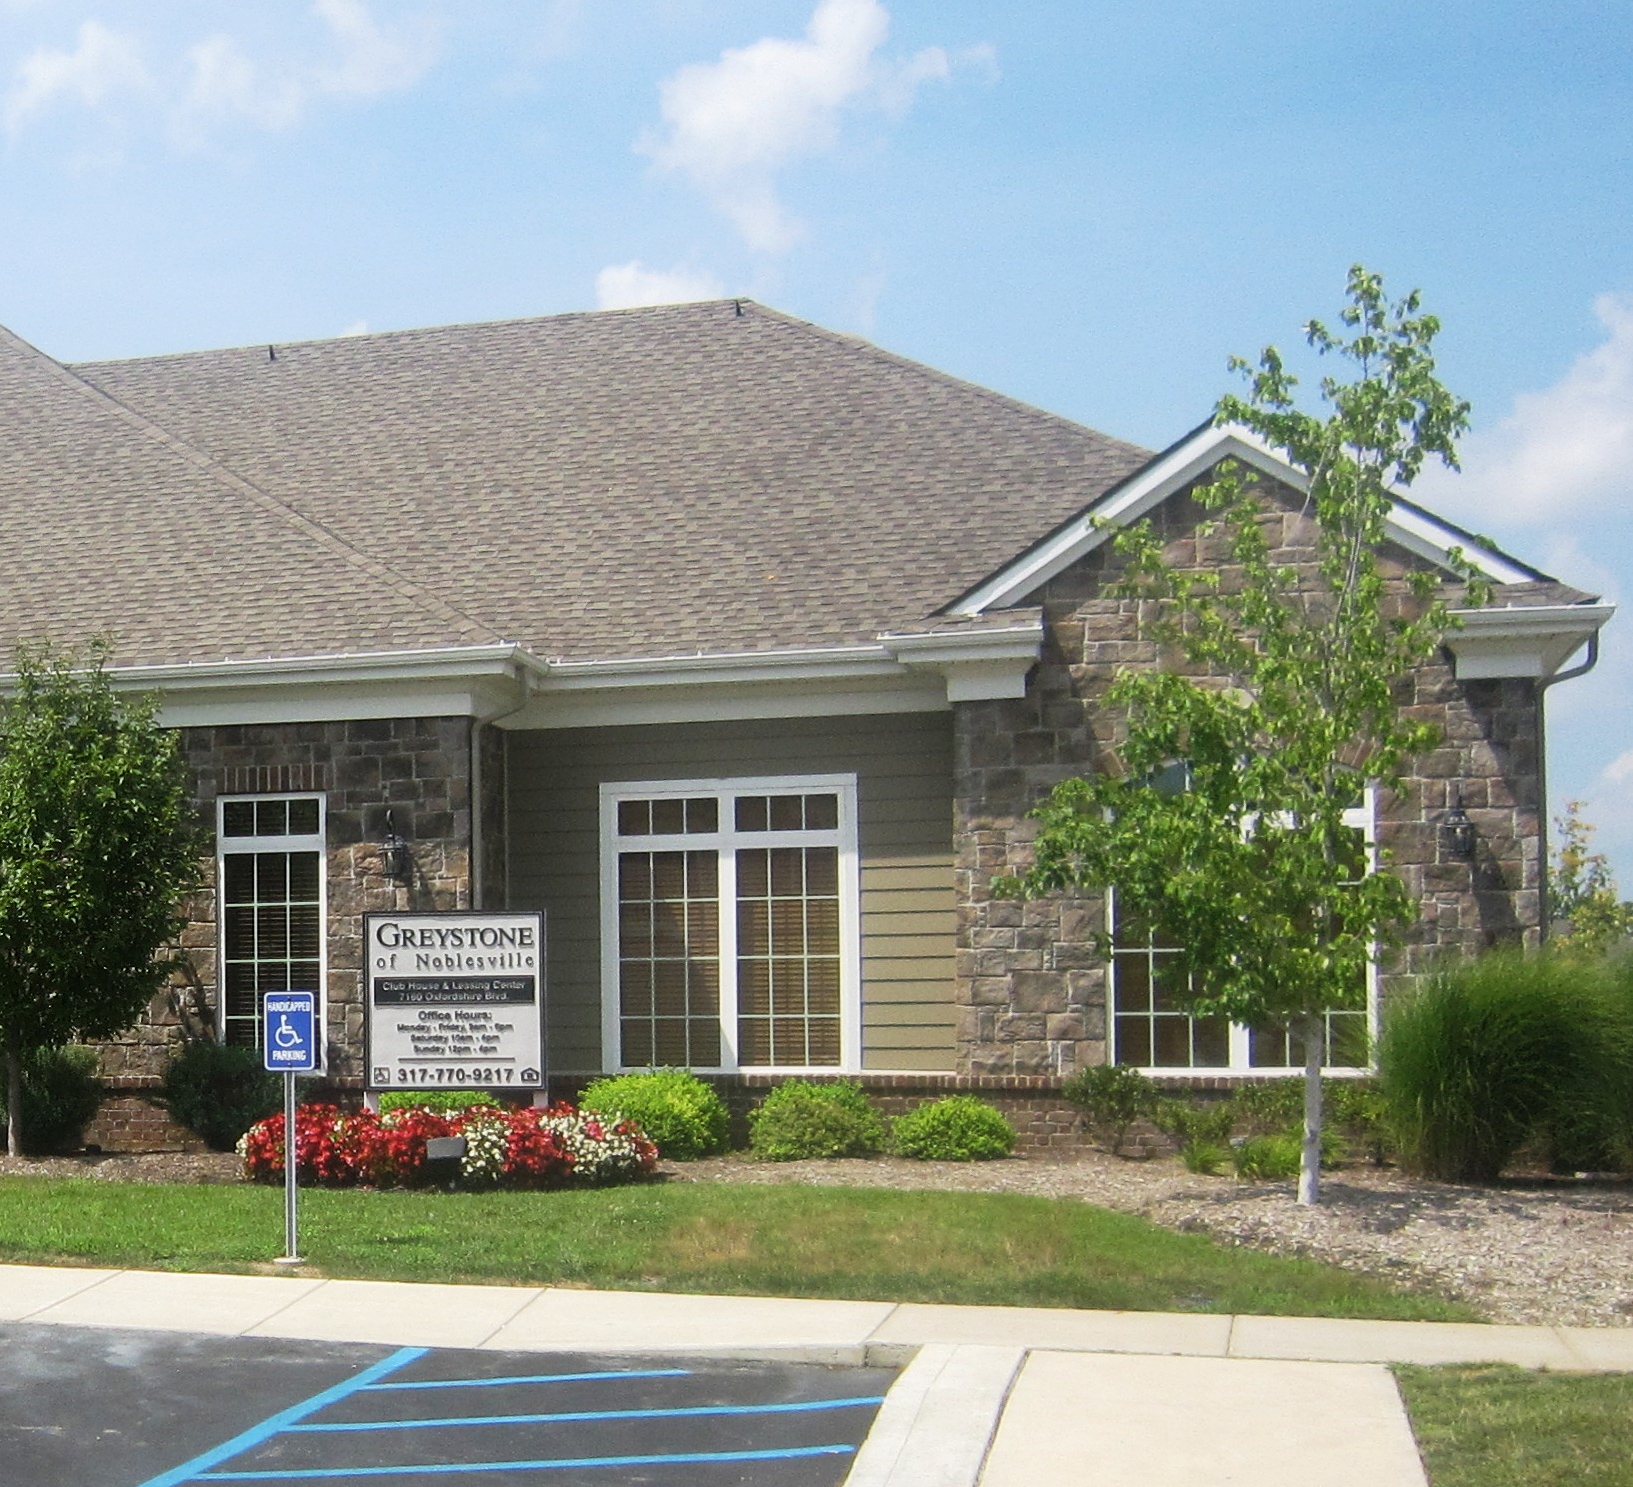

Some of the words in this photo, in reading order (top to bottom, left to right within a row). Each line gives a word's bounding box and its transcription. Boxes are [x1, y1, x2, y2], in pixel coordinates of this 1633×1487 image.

[376, 922, 535, 948] GREYSTONE
[376, 953, 396, 969] of
[415, 952, 534, 971] Noblesville
[382, 981, 406, 991] Club
[408, 980, 439, 990] House
[442, 979, 449, 989] &
[452, 979, 490, 991] Leasing
[492, 979, 526, 989] Center
[425, 992, 482, 1001] Oxfordshire
[267, 1001, 311, 1012] HANDICAPPED
[418, 1010, 452, 1021] Office
[455, 1010, 492, 1021] Hours:
[397, 1023, 431, 1033] Monday
[410, 1034, 449, 1045] Saturday
[272, 1050, 306, 1061] PARKING
[413, 1045, 445, 1056] Sunday
[397, 1067, 514, 1083] 317-770-9217
